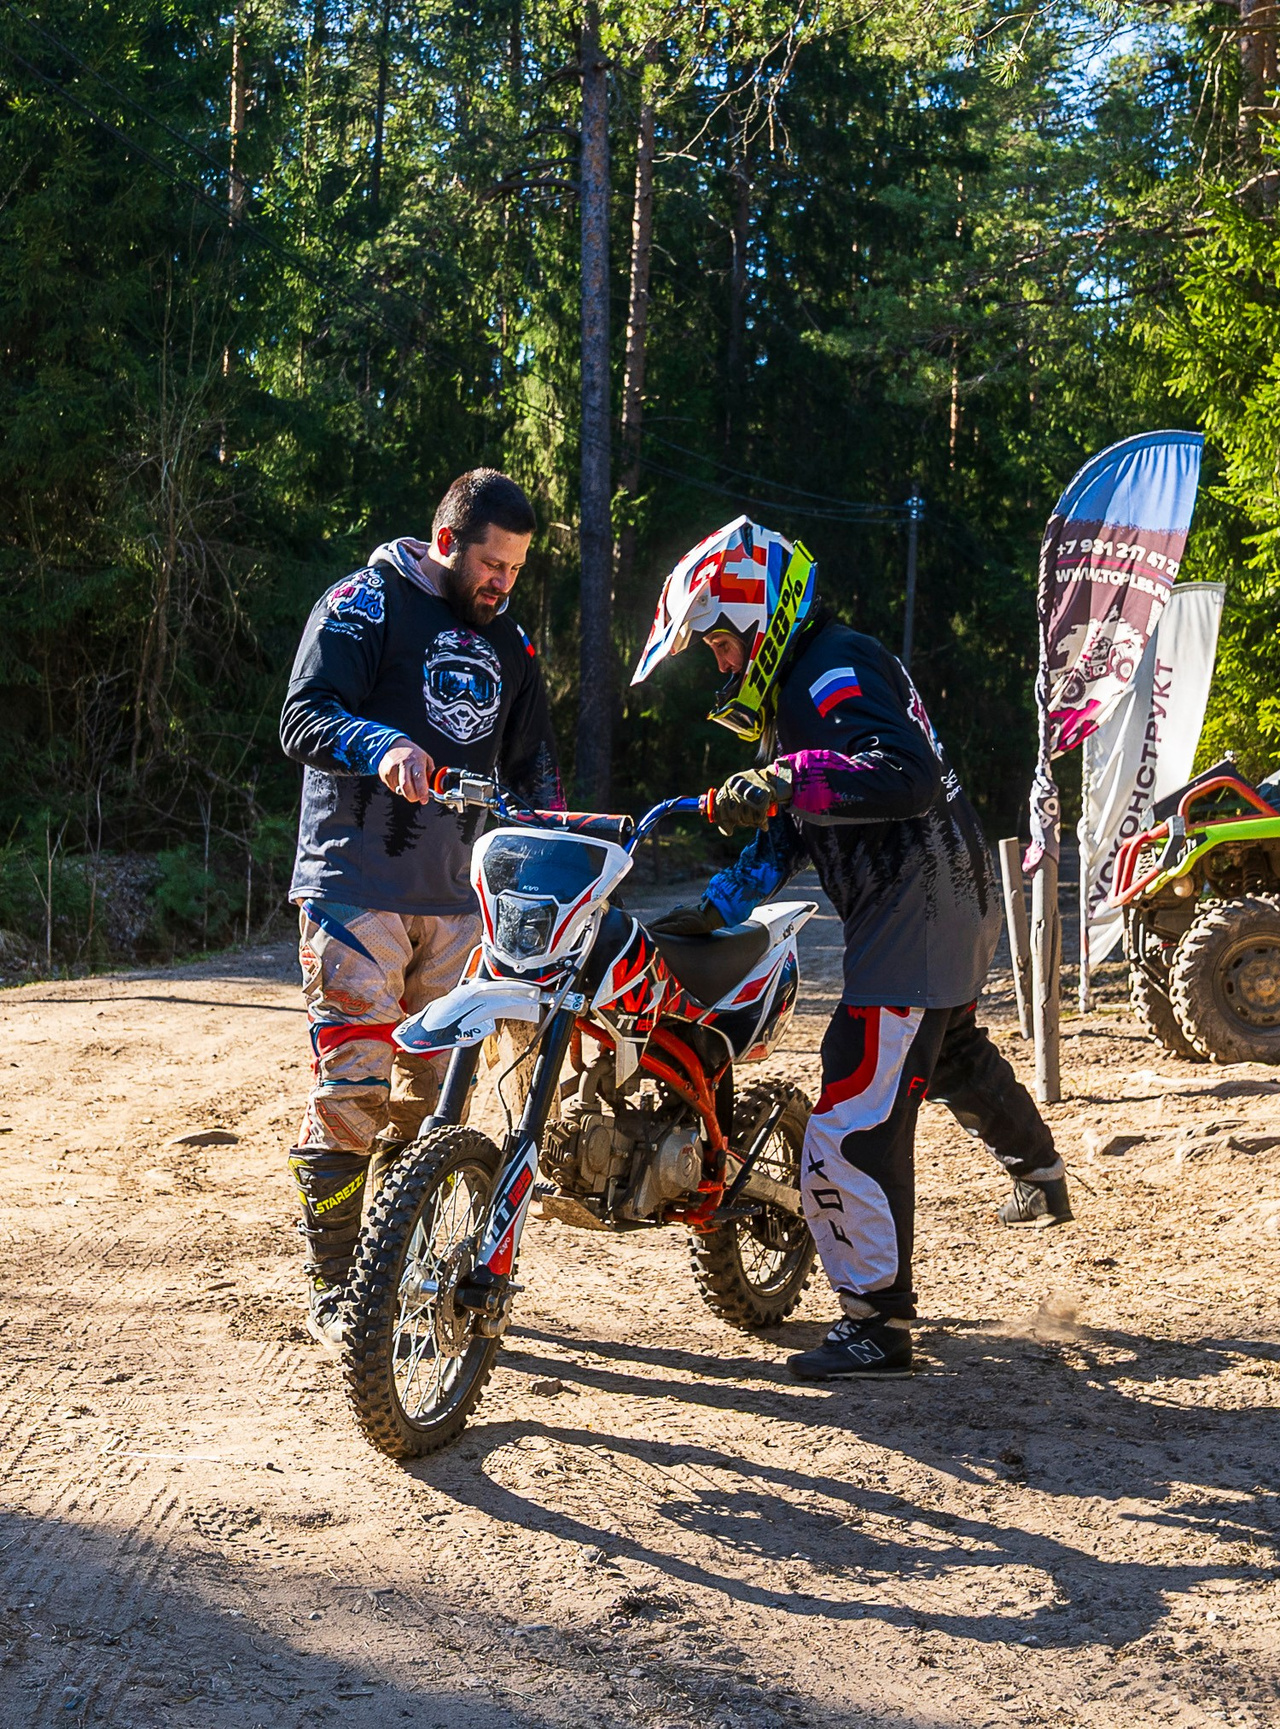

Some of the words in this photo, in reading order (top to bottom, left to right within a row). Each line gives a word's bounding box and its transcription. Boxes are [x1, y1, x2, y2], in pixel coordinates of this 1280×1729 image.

[1057, 539, 1077, 555] +7
[1080, 538, 1112, 556] 931
[1115, 542, 1146, 562] 217
[1146, 550, 1167, 570] 47
[748, 574, 803, 693] 100%
[616, 1014, 638, 1030] TT
[508, 1166, 533, 1207] 125
[807, 1148, 854, 1249] FOX
